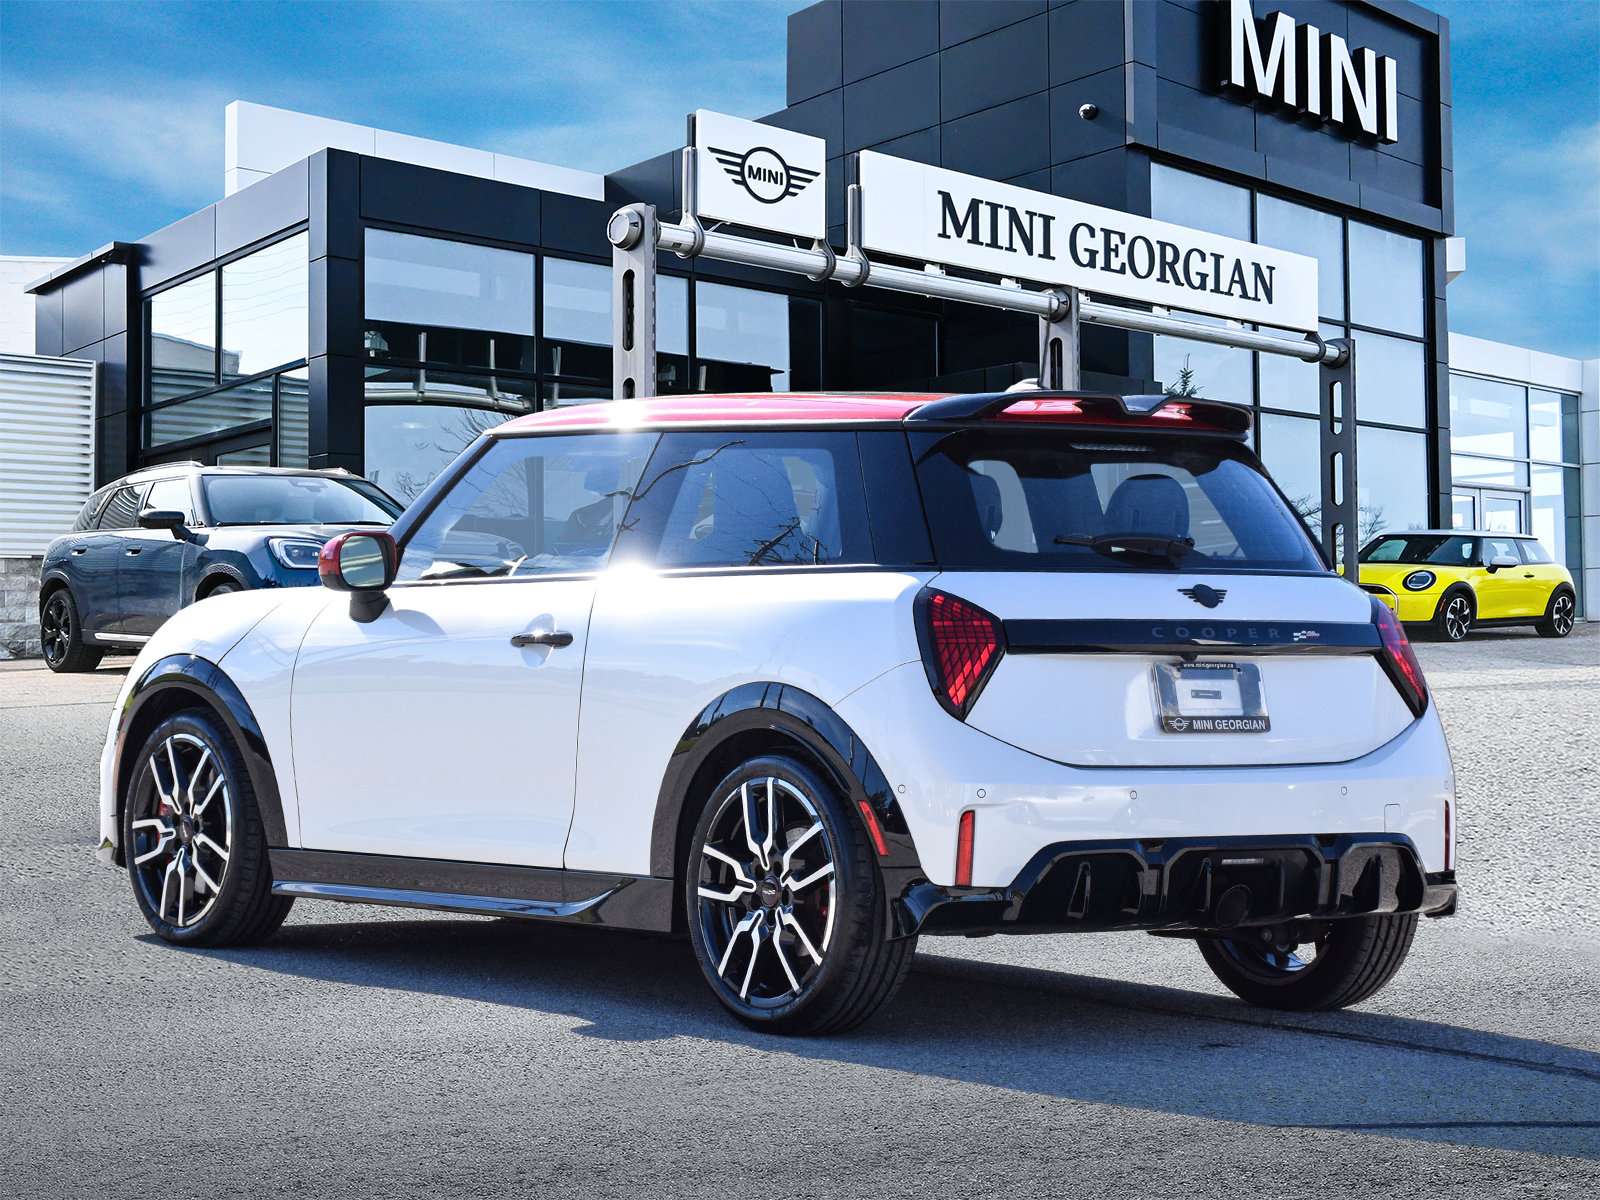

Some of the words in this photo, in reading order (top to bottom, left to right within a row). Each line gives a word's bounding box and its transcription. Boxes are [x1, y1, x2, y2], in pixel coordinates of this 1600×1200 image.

[1231, 0, 1398, 142] MINI
[748, 165, 783, 186] MINI
[937, 190, 1056, 261] MINI
[1069, 222, 1275, 305] GEORGIAN
[1151, 627, 1281, 639] COOPER
[1193, 719, 1213, 730] MINI
[1215, 719, 1266, 730] GEORGIAN
